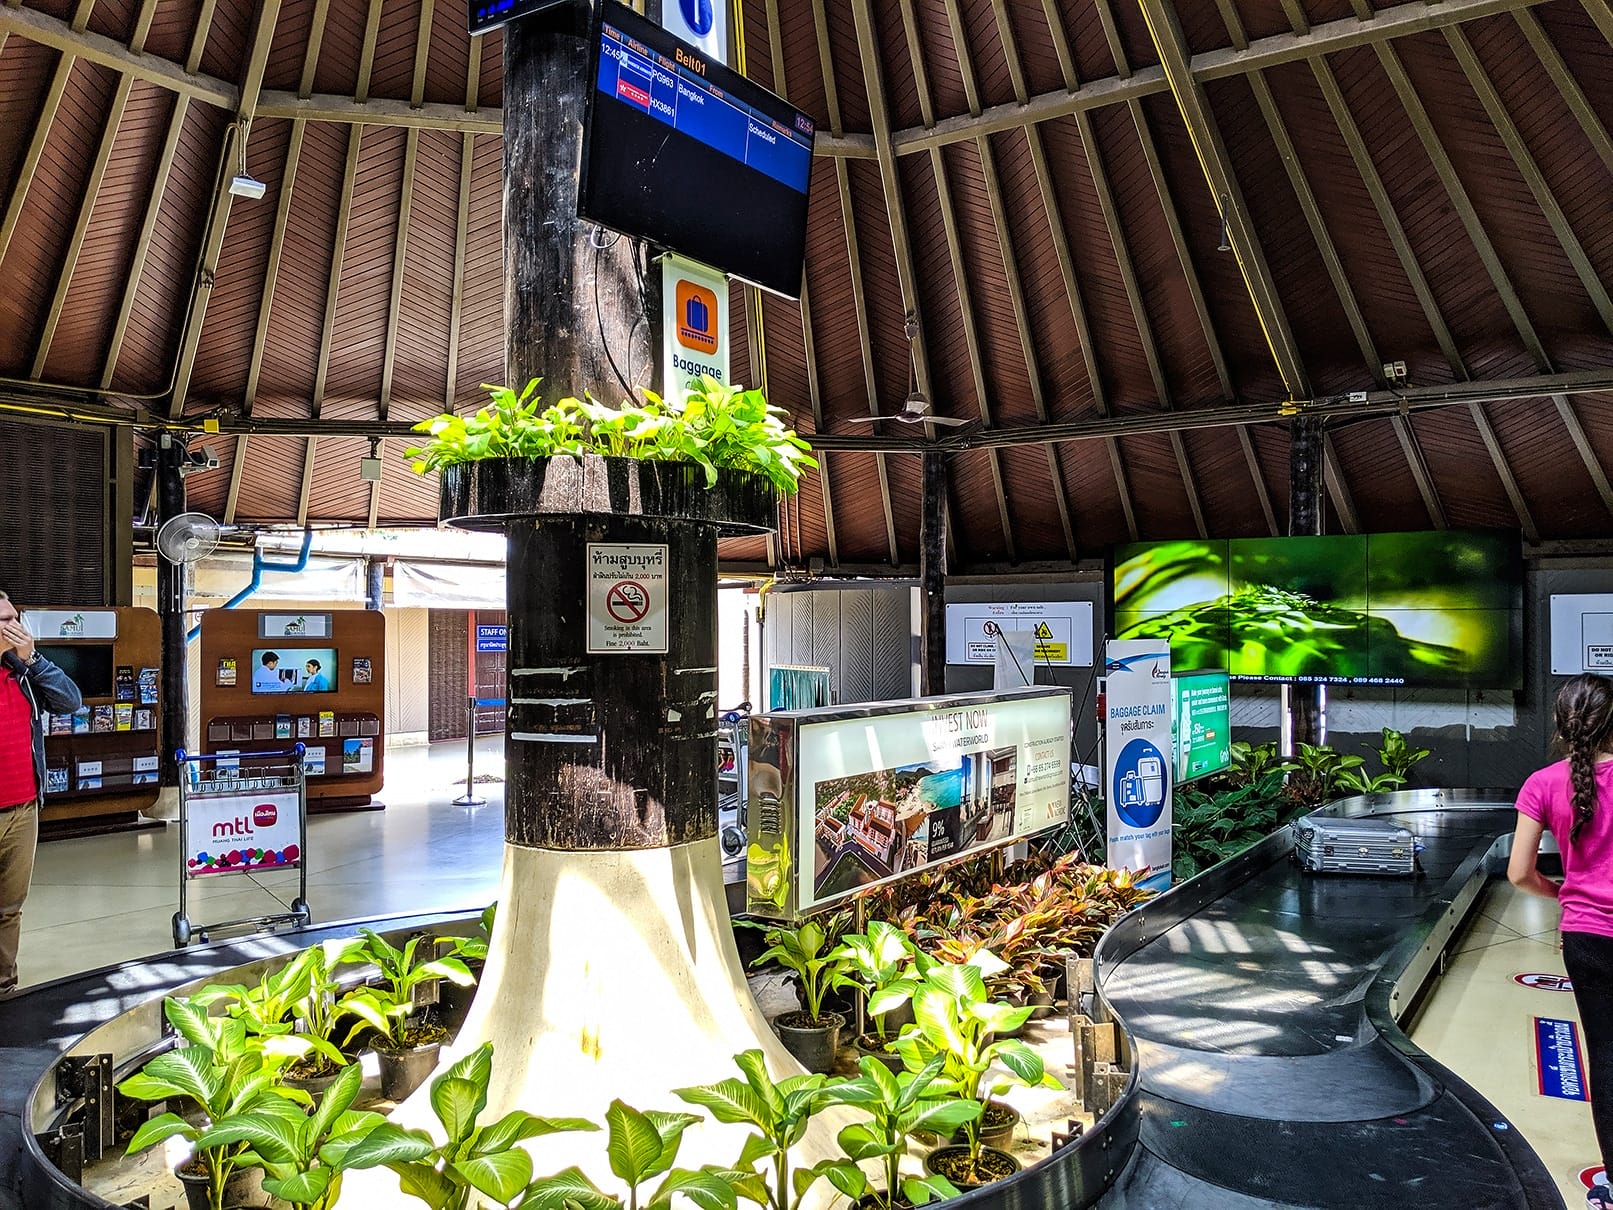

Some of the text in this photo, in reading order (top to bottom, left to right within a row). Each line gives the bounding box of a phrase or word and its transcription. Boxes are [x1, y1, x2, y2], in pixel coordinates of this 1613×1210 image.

[604, 25, 620, 40] Time
[602, 44, 620, 60] 12:45
[628, 39, 649, 56] Airline
[658, 56, 676, 71] Flight
[675, 48, 706, 76] Belt01
[652, 70, 674, 88] PG963
[678, 84, 704, 105] Bangkok
[709, 84, 724, 98] From
[650, 97, 674, 116] HX3861
[748, 123, 776, 144] Scheduled
[673, 354, 722, 380] Baggage
[966, 709, 988, 730] NOW
[1110, 704, 1166, 718] BAGGAGE CLAIM
[212, 816, 254, 837] mtl
[932, 819, 945, 838] 9%
